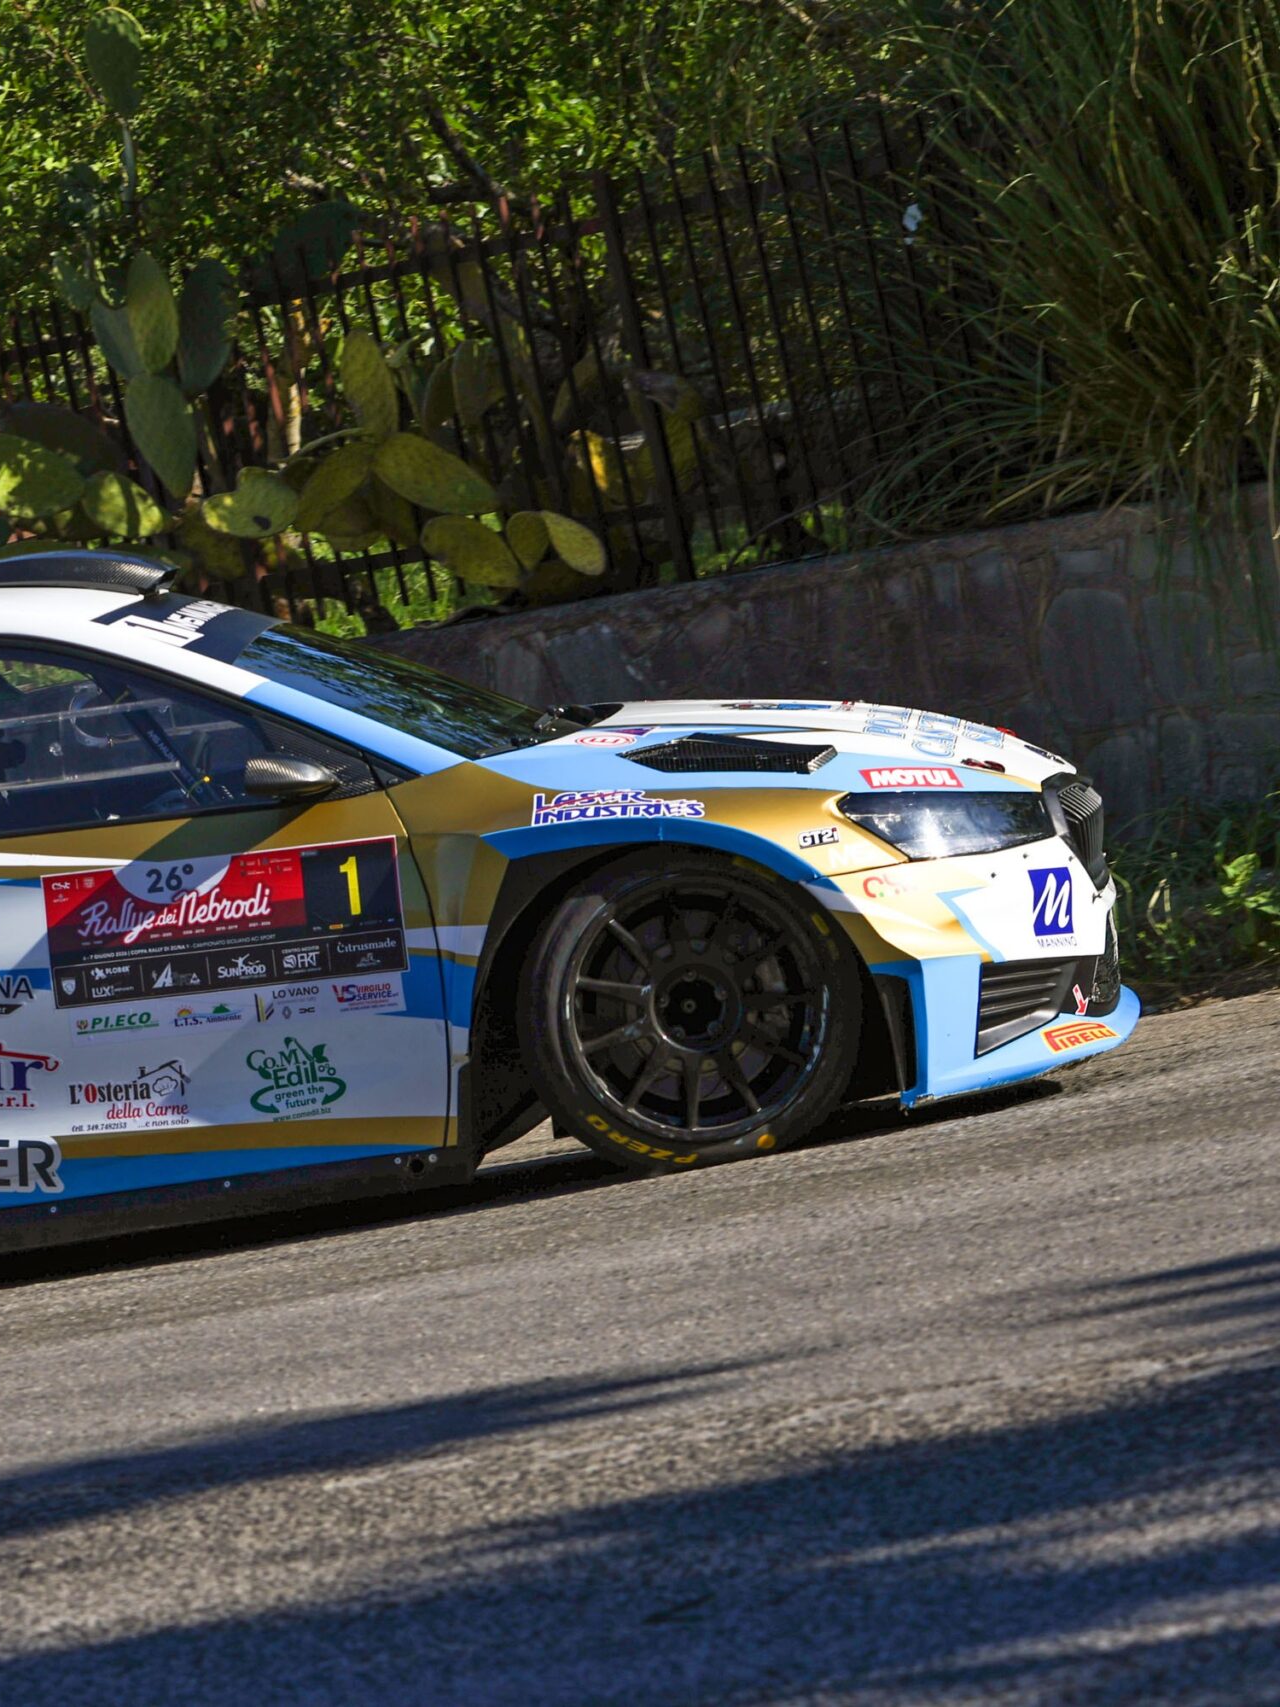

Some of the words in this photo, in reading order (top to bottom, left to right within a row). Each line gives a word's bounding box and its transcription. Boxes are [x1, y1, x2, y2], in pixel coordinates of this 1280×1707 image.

[870, 768, 959, 788] MOTUL
[339, 856, 362, 916] 1
[77, 897, 156, 944] Rallye
[155, 907, 178, 927] dei
[177, 883, 272, 927] Nebrodi
[337, 937, 397, 953] Citrusmade
[1037, 935, 1077, 948] MANNINO
[272, 988, 287, 999] LO
[289, 985, 320, 998] VANO
[356, 983, 391, 993] VIRGILIO
[356, 991, 392, 1001] SERVICE
[91, 1012, 152, 1029] PI.ECO
[1042, 1022, 1118, 1052] PIRELLI
[273, 1061, 318, 1089] Edil
[275, 1089, 305, 1103] green
[307, 1084, 325, 1095] the
[106, 1102, 141, 1119] della
[146, 1102, 189, 1117] Carne
[285, 1097, 317, 1109] future
[152, 1119, 169, 1127] non
[171, 1116, 190, 1126] solo
